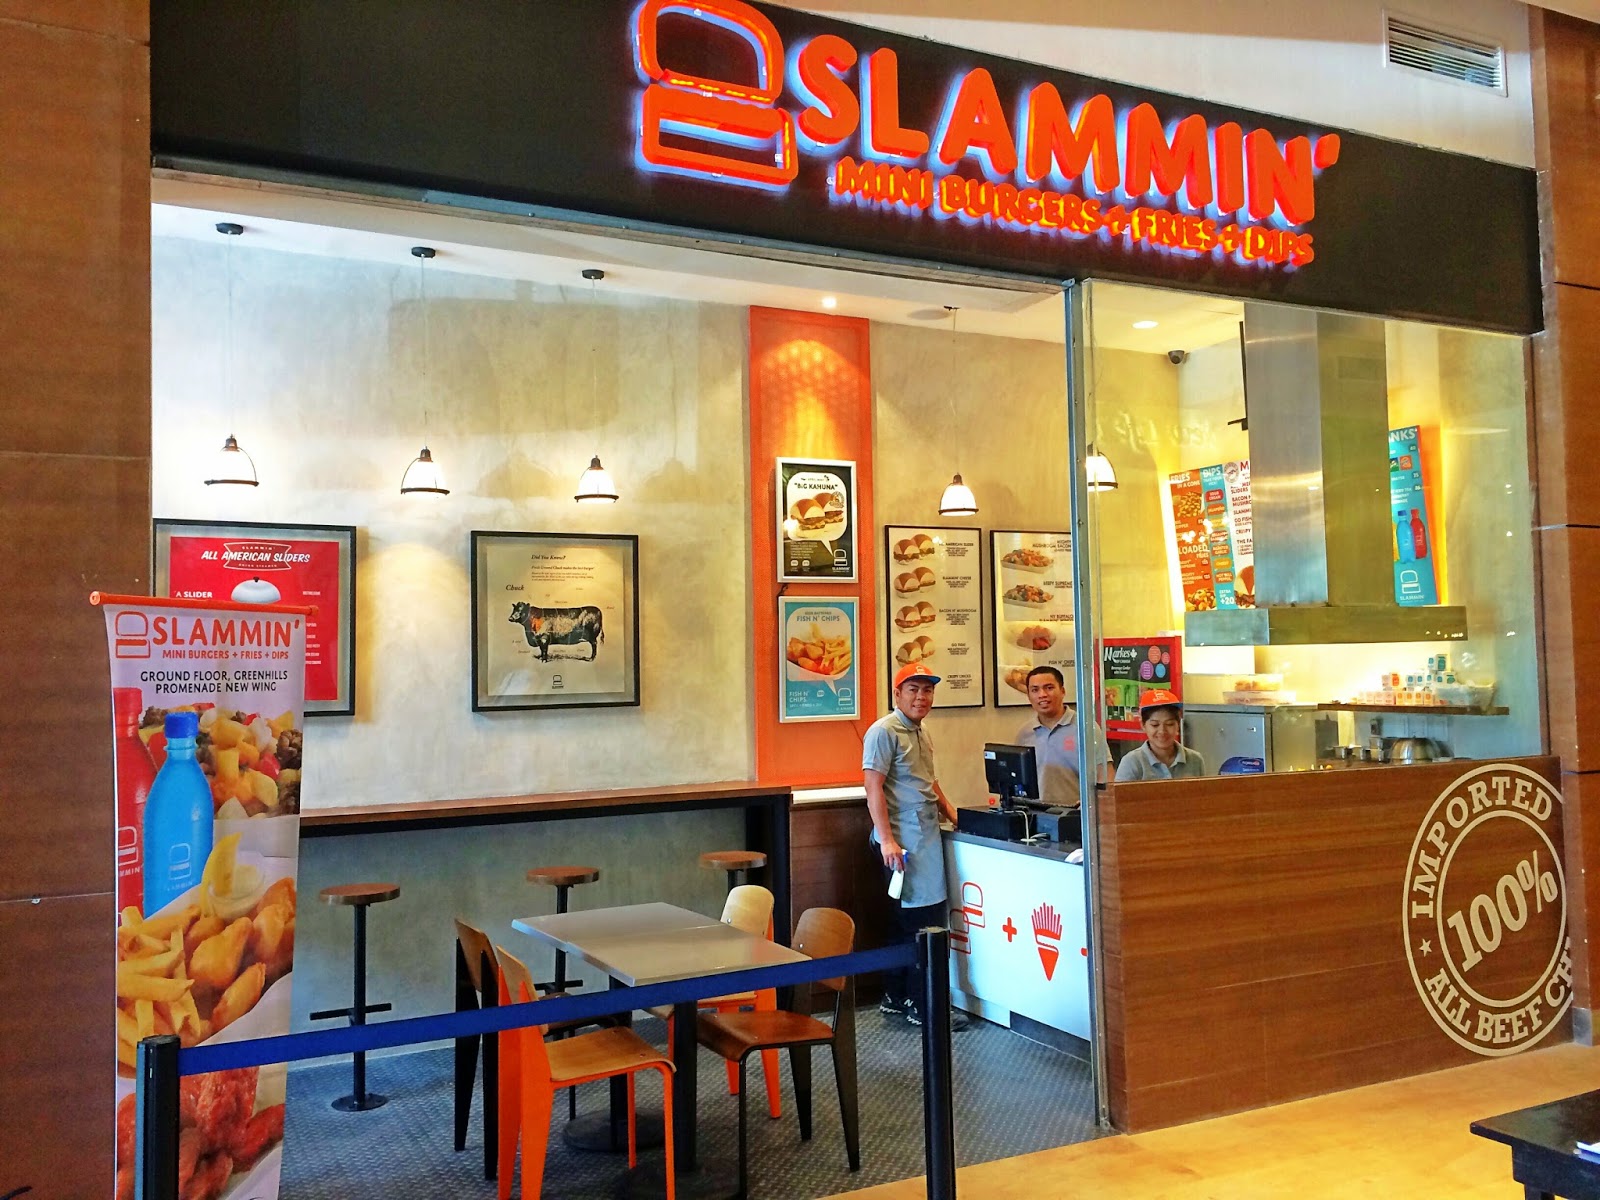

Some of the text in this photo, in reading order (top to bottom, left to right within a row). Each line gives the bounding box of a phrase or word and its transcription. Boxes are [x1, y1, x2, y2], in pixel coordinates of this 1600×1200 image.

[798, 34, 1340, 225] SLAMMIN'
[835, 156, 934, 210] MINI
[939, 175, 1100, 236] BURGERS
[1130, 206, 1218, 252] FRIES
[1244, 226, 1314, 267] DIPS
[1389, 428, 1416, 442] NKS
[201, 550, 311, 563] ALL AMERICAN SLIDERS
[152, 616, 300, 648] SLAMMIN'
[162, 650, 186, 660] MINI
[188, 650, 230, 660] BURGERS
[240, 650, 263, 660] FRIES
[271, 651, 289, 660] DIPS
[140, 670, 288, 683] GROUND FLOOR, GREENHILLS
[155, 682, 277, 694] PROMENADE NEW WING
[1411, 775, 1553, 919] IMPORTED
[1446, 849, 1559, 973] 100%
[1424, 936, 1573, 1044] ALL BEEF CH
